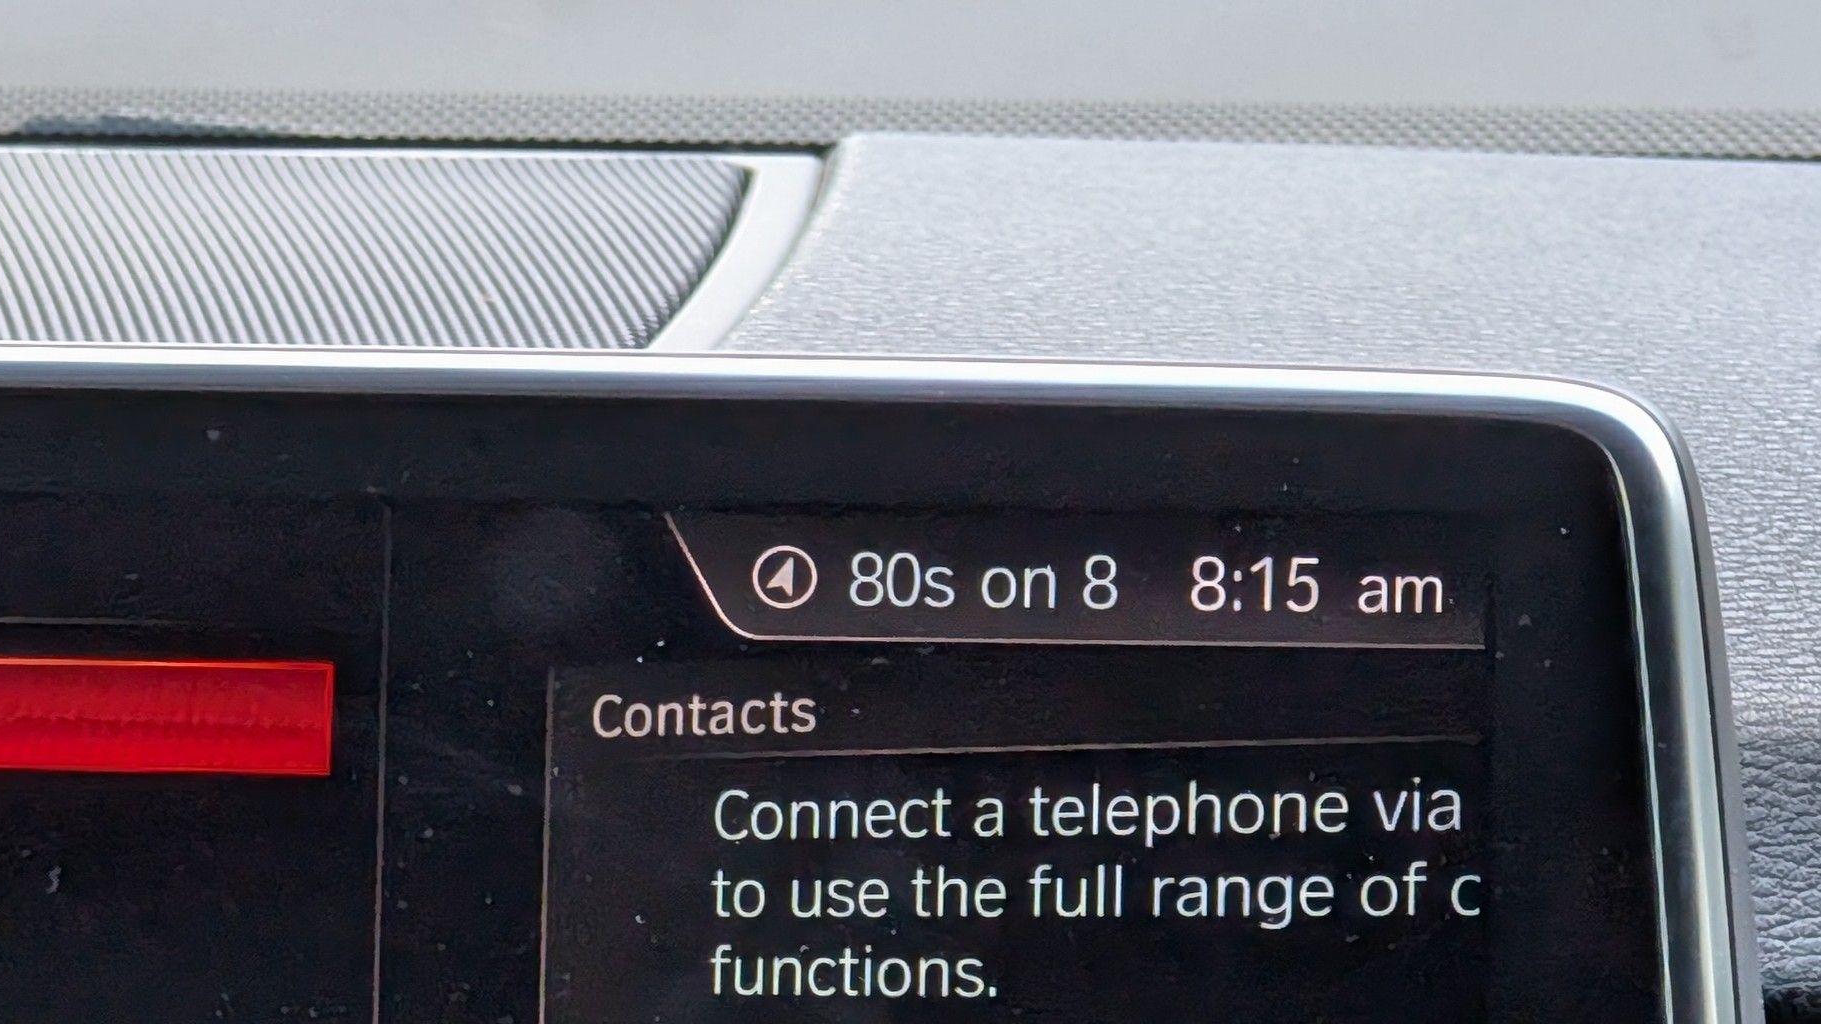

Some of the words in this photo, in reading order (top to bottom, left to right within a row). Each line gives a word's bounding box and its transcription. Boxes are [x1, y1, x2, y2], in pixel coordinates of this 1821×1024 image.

[849, 551, 956, 609] 80s
[980, 564, 1056, 609] on
[1082, 554, 1119, 611] 8
[1190, 555, 1320, 613] 8:15
[1357, 575, 1441, 614] am
[592, 691, 817, 738] Contacts
[714, 787, 952, 841] Connect
[973, 797, 1004, 838] a
[1028, 780, 1349, 848] telephone
[1373, 776, 1461, 832] via
[710, 868, 766, 918] to
[791, 878, 890, 918] use
[910, 864, 1007, 918] the
[1028, 863, 1123, 918] full
[1152, 875, 1335, 930] range
[1360, 860, 1428, 917] of
[709, 943, 997, 998] functions.
